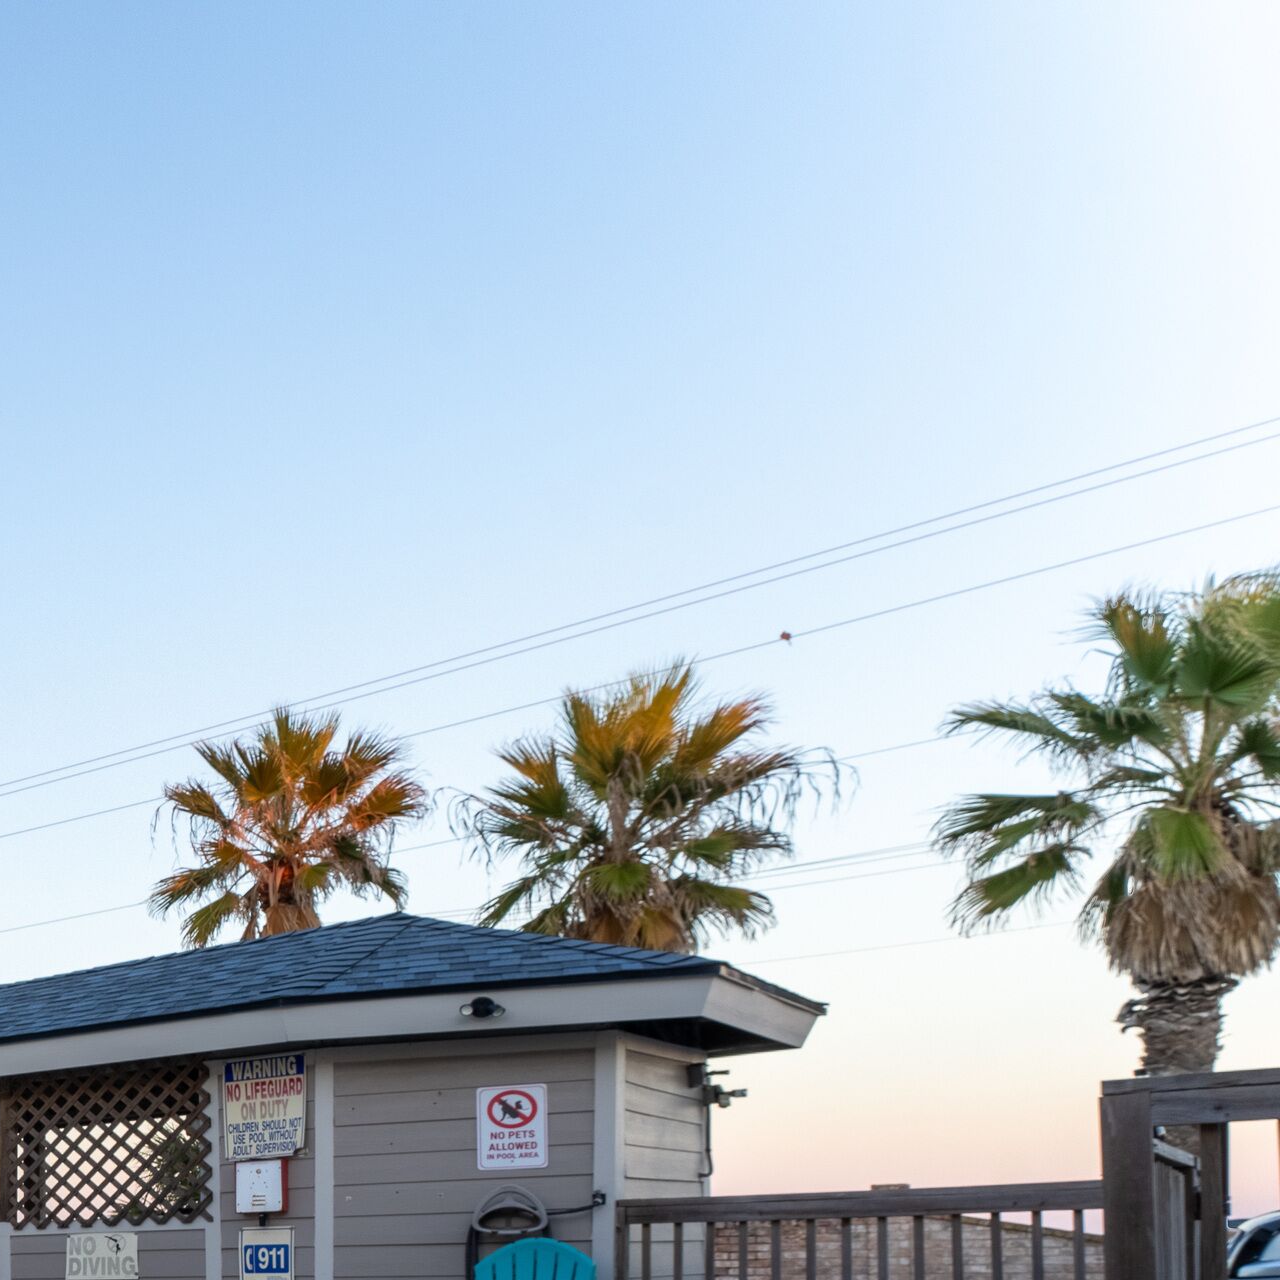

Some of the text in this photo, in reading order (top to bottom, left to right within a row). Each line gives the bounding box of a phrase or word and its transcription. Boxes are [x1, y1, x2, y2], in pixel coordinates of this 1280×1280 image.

[231, 1056, 297, 1081] WARNING
[227, 1077, 303, 1102] NO LIFEGUARD
[240, 1099, 289, 1120] ON DUTY
[228, 1117, 303, 1134] CHILDREN SHOULD NOT
[490, 1129, 536, 1140] NO PETS
[233, 1129, 298, 1145] USE POOL WITHOUT
[232, 1141, 298, 1157] ADULT SUPERVISION
[488, 1141, 538, 1152] ALLOWED
[497, 1152, 517, 1160] POOL
[518, 1151, 539, 1159] AREA
[69, 1236, 96, 1256] NO
[68, 1256, 136, 1276] DIVING
[258, 1247, 285, 1270] 911
